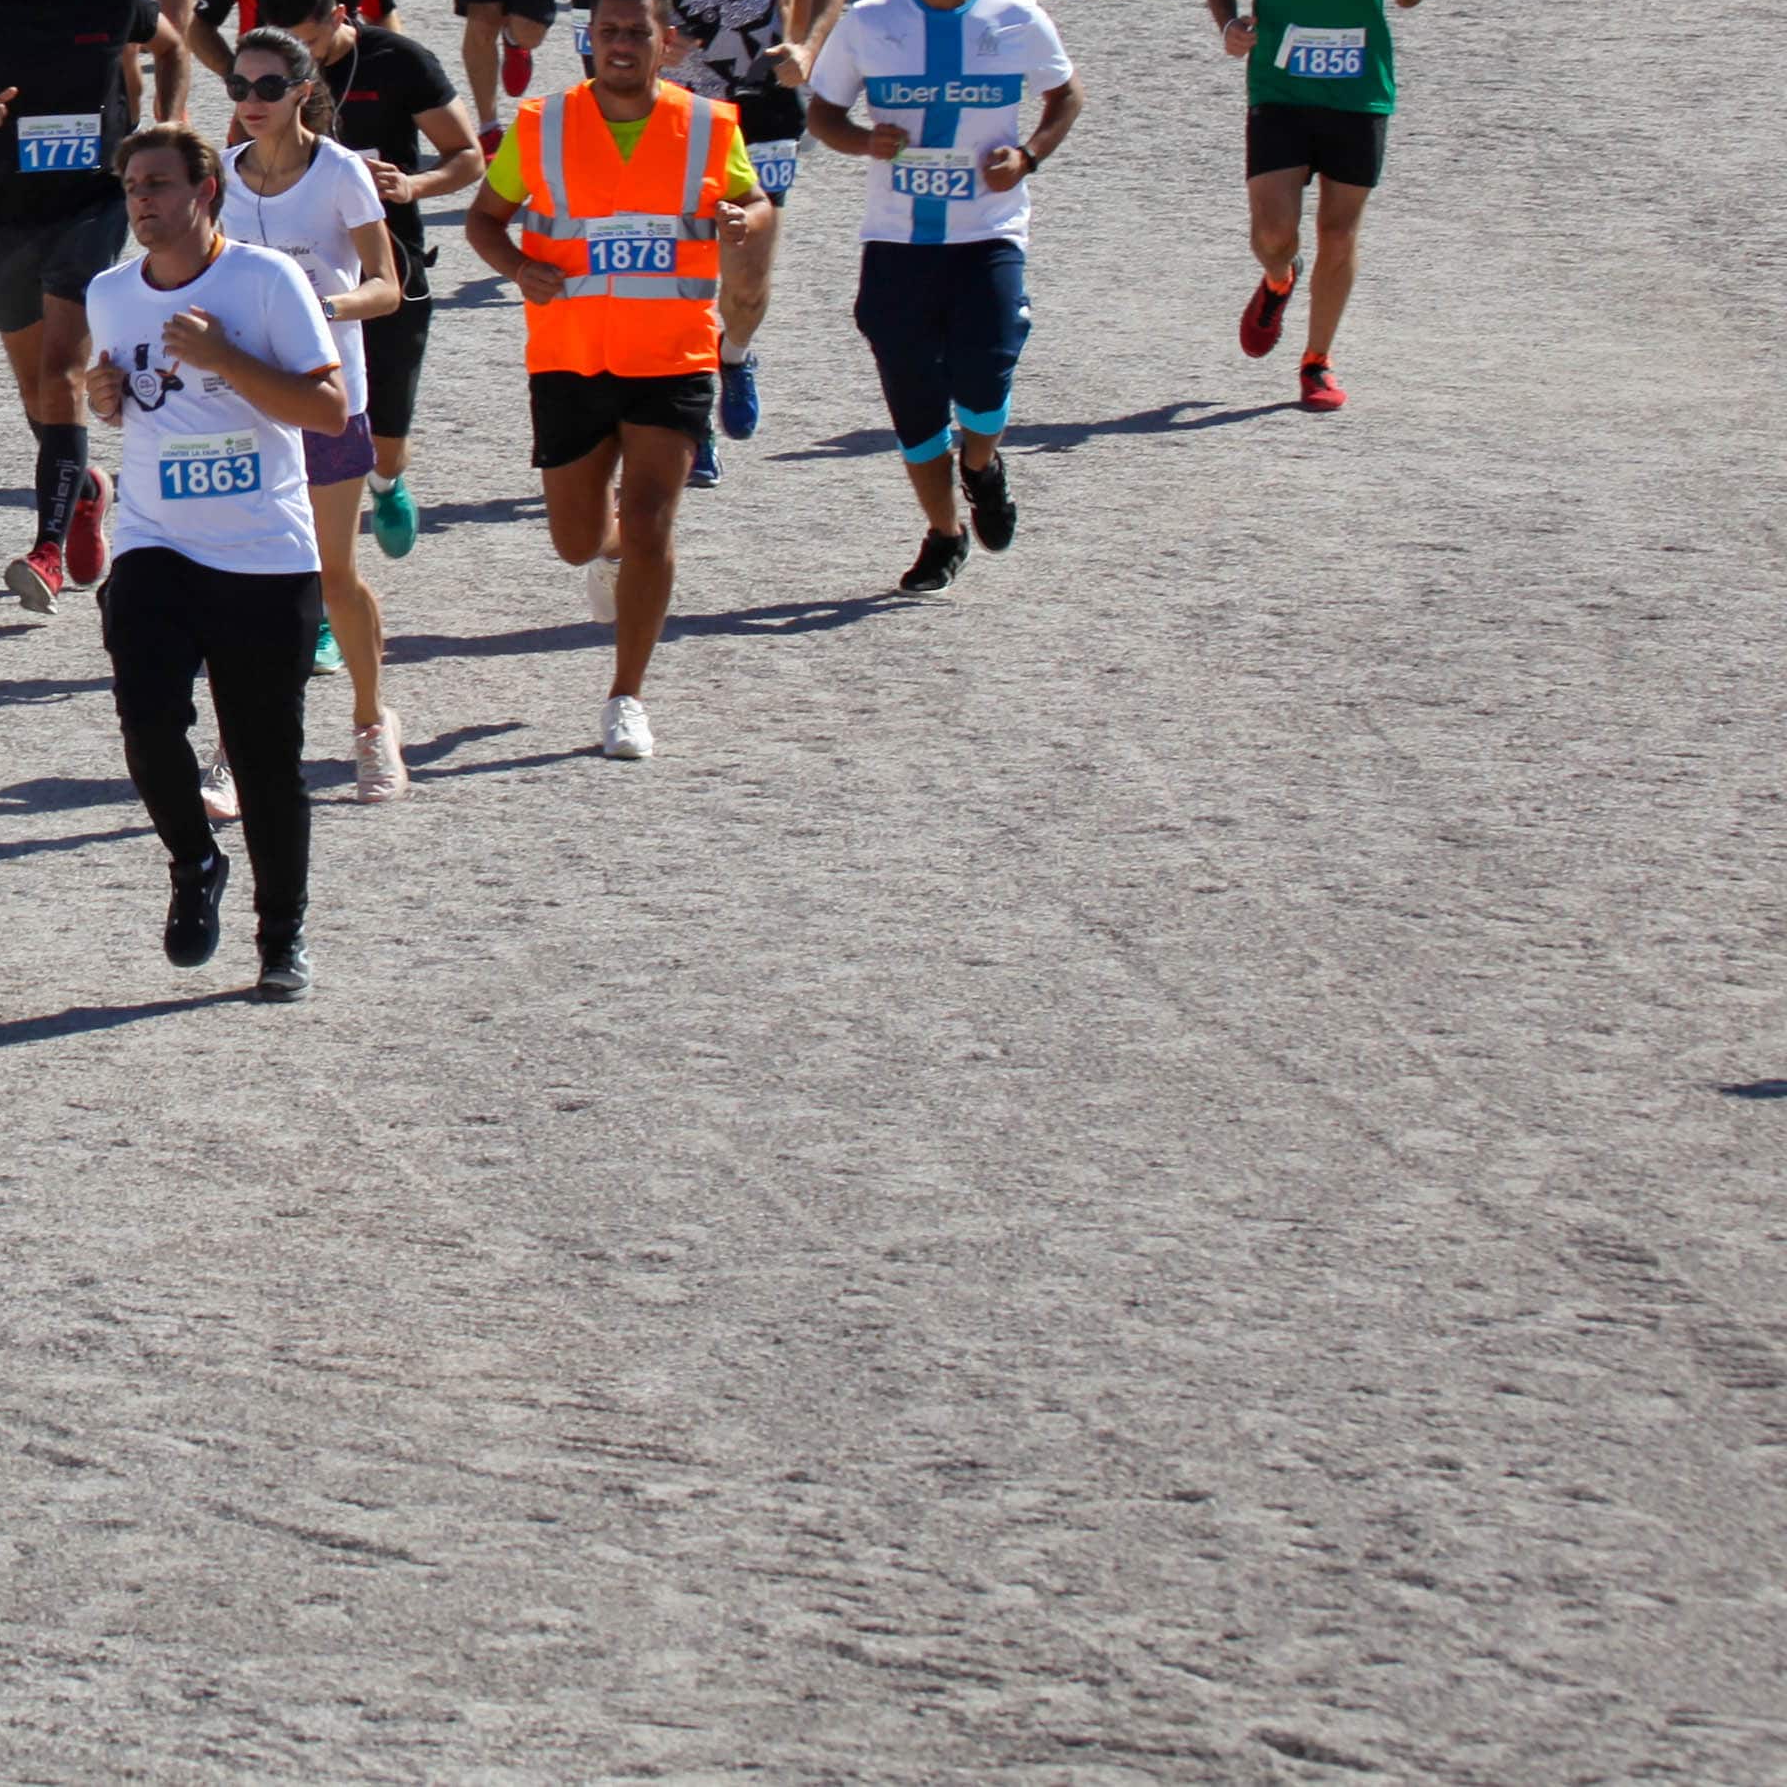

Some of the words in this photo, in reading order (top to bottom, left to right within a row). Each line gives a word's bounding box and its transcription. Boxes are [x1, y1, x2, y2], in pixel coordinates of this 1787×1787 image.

[1293, 47, 1361, 75] 1856
[880, 81, 939, 103] Uber
[944, 81, 1004, 103] Eats
[24, 137, 97, 168] 1775
[894, 166, 971, 198] 1882
[591, 239, 672, 270] 1878
[165, 456, 256, 494] 1863
[46, 459, 81, 534] kalenji
